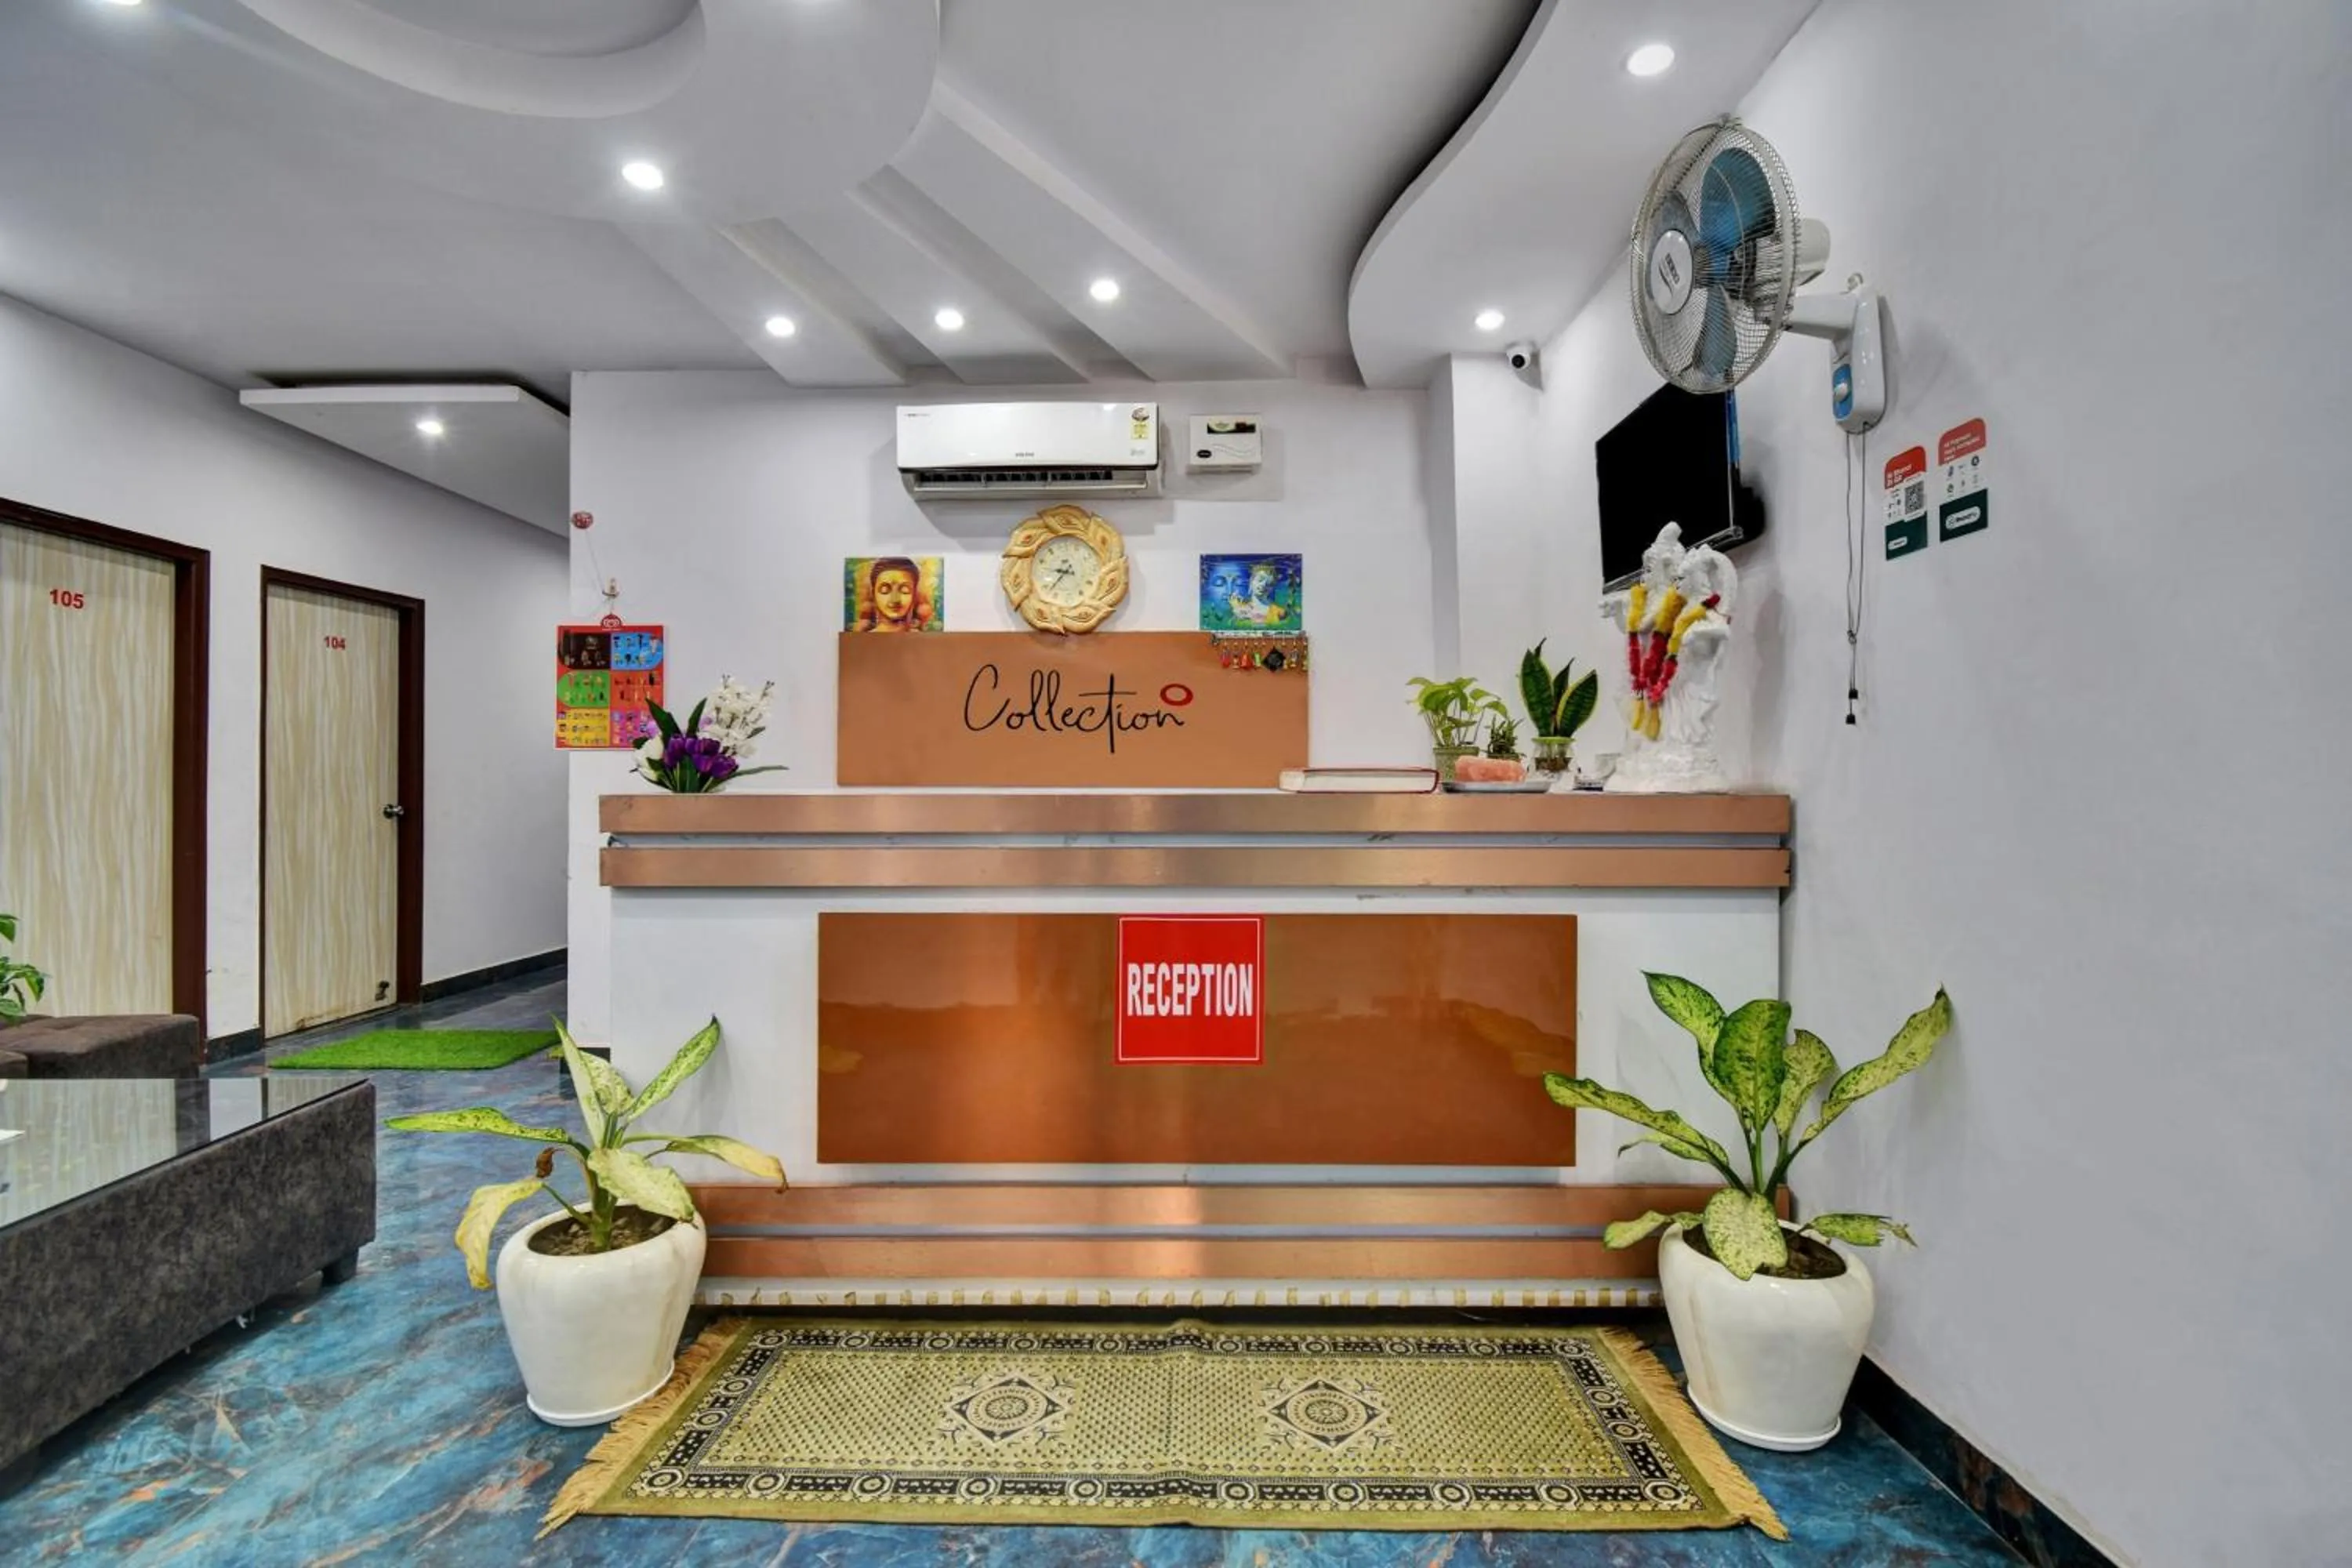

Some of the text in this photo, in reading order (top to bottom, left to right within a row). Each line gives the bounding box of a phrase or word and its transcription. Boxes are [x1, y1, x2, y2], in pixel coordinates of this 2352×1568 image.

[49, 589, 84, 609] 105
[323, 635, 347, 651] 104
[964, 663, 1185, 754] Collection
[1127, 961, 1254, 1017] RECEPTION
